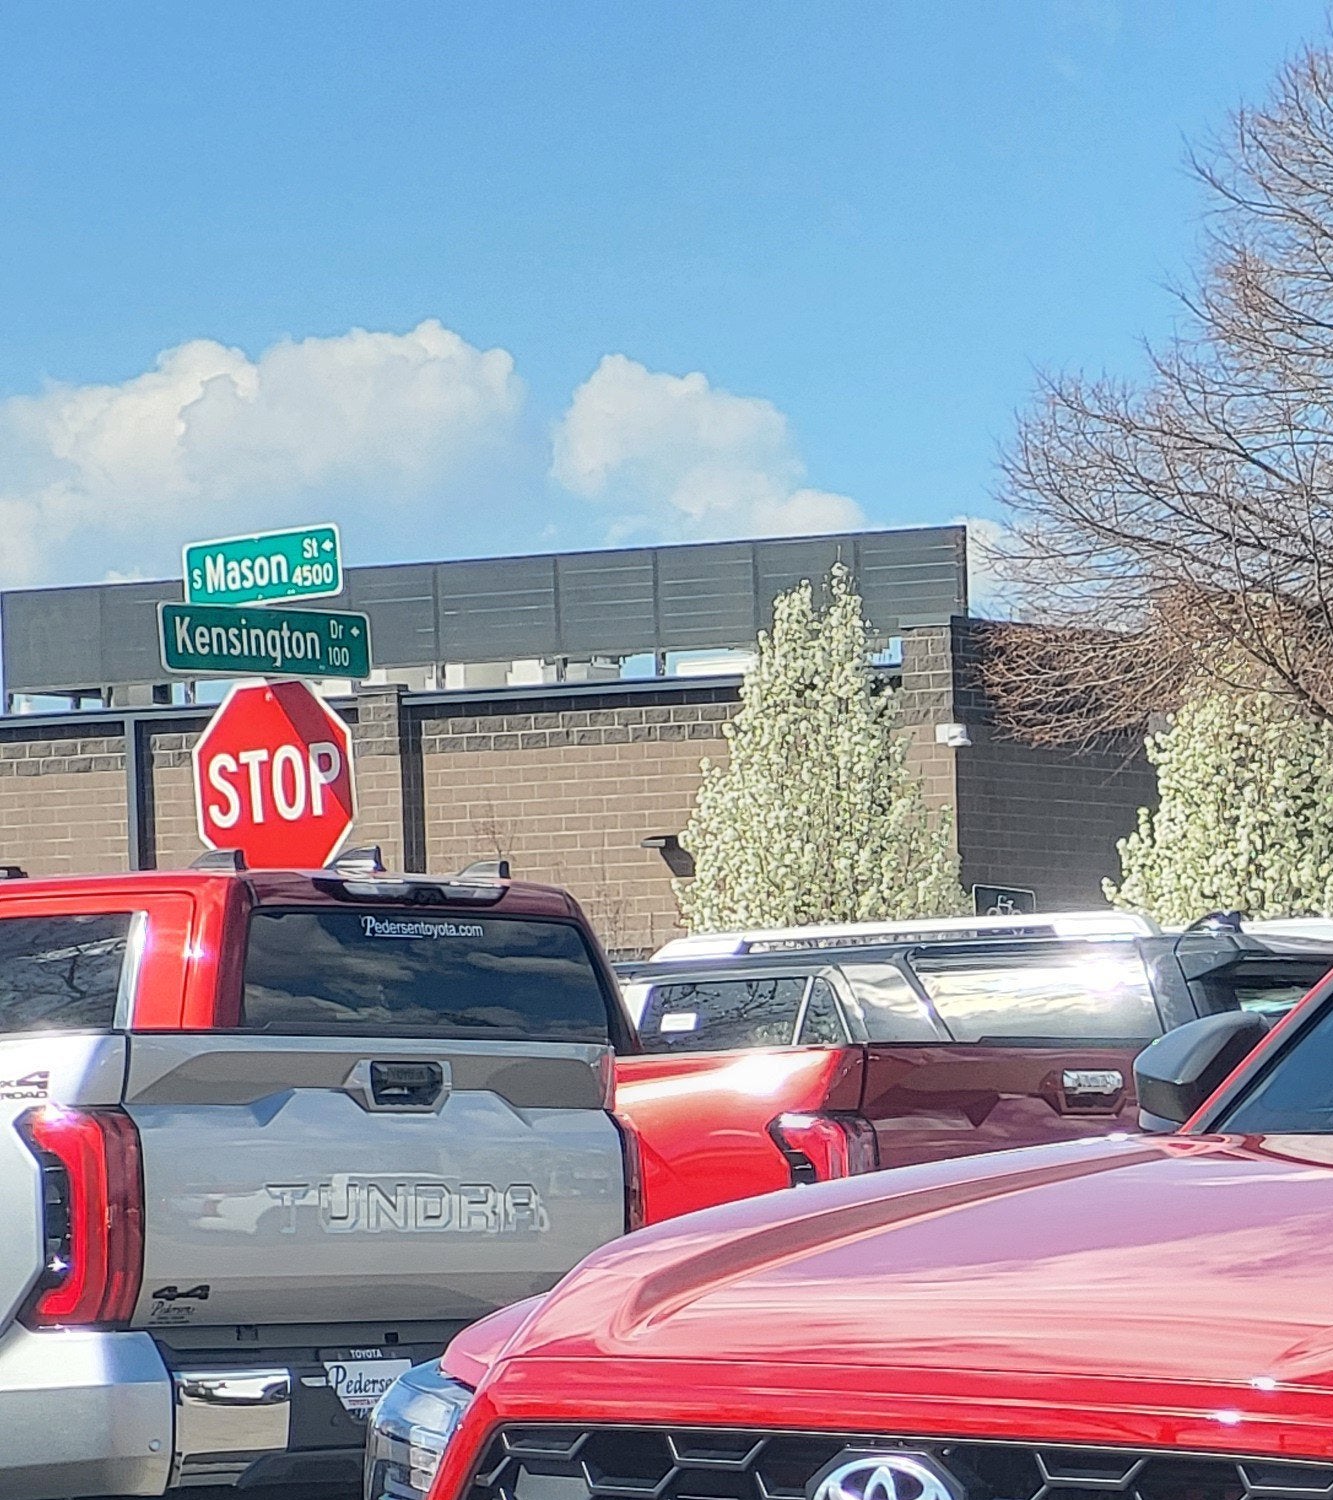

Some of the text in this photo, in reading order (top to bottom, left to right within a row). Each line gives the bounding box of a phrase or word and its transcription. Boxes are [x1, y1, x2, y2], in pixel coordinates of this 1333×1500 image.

[192, 537, 319, 594] S Mason St
[291, 562, 334, 587] 4500
[174, 616, 344, 667] Kensington Dr
[328, 646, 350, 667] 100
[208, 741, 341, 829] STOP
[264, 1183, 541, 1233] TUNDRA
[349, 1349, 382, 1359] TOYOTA
